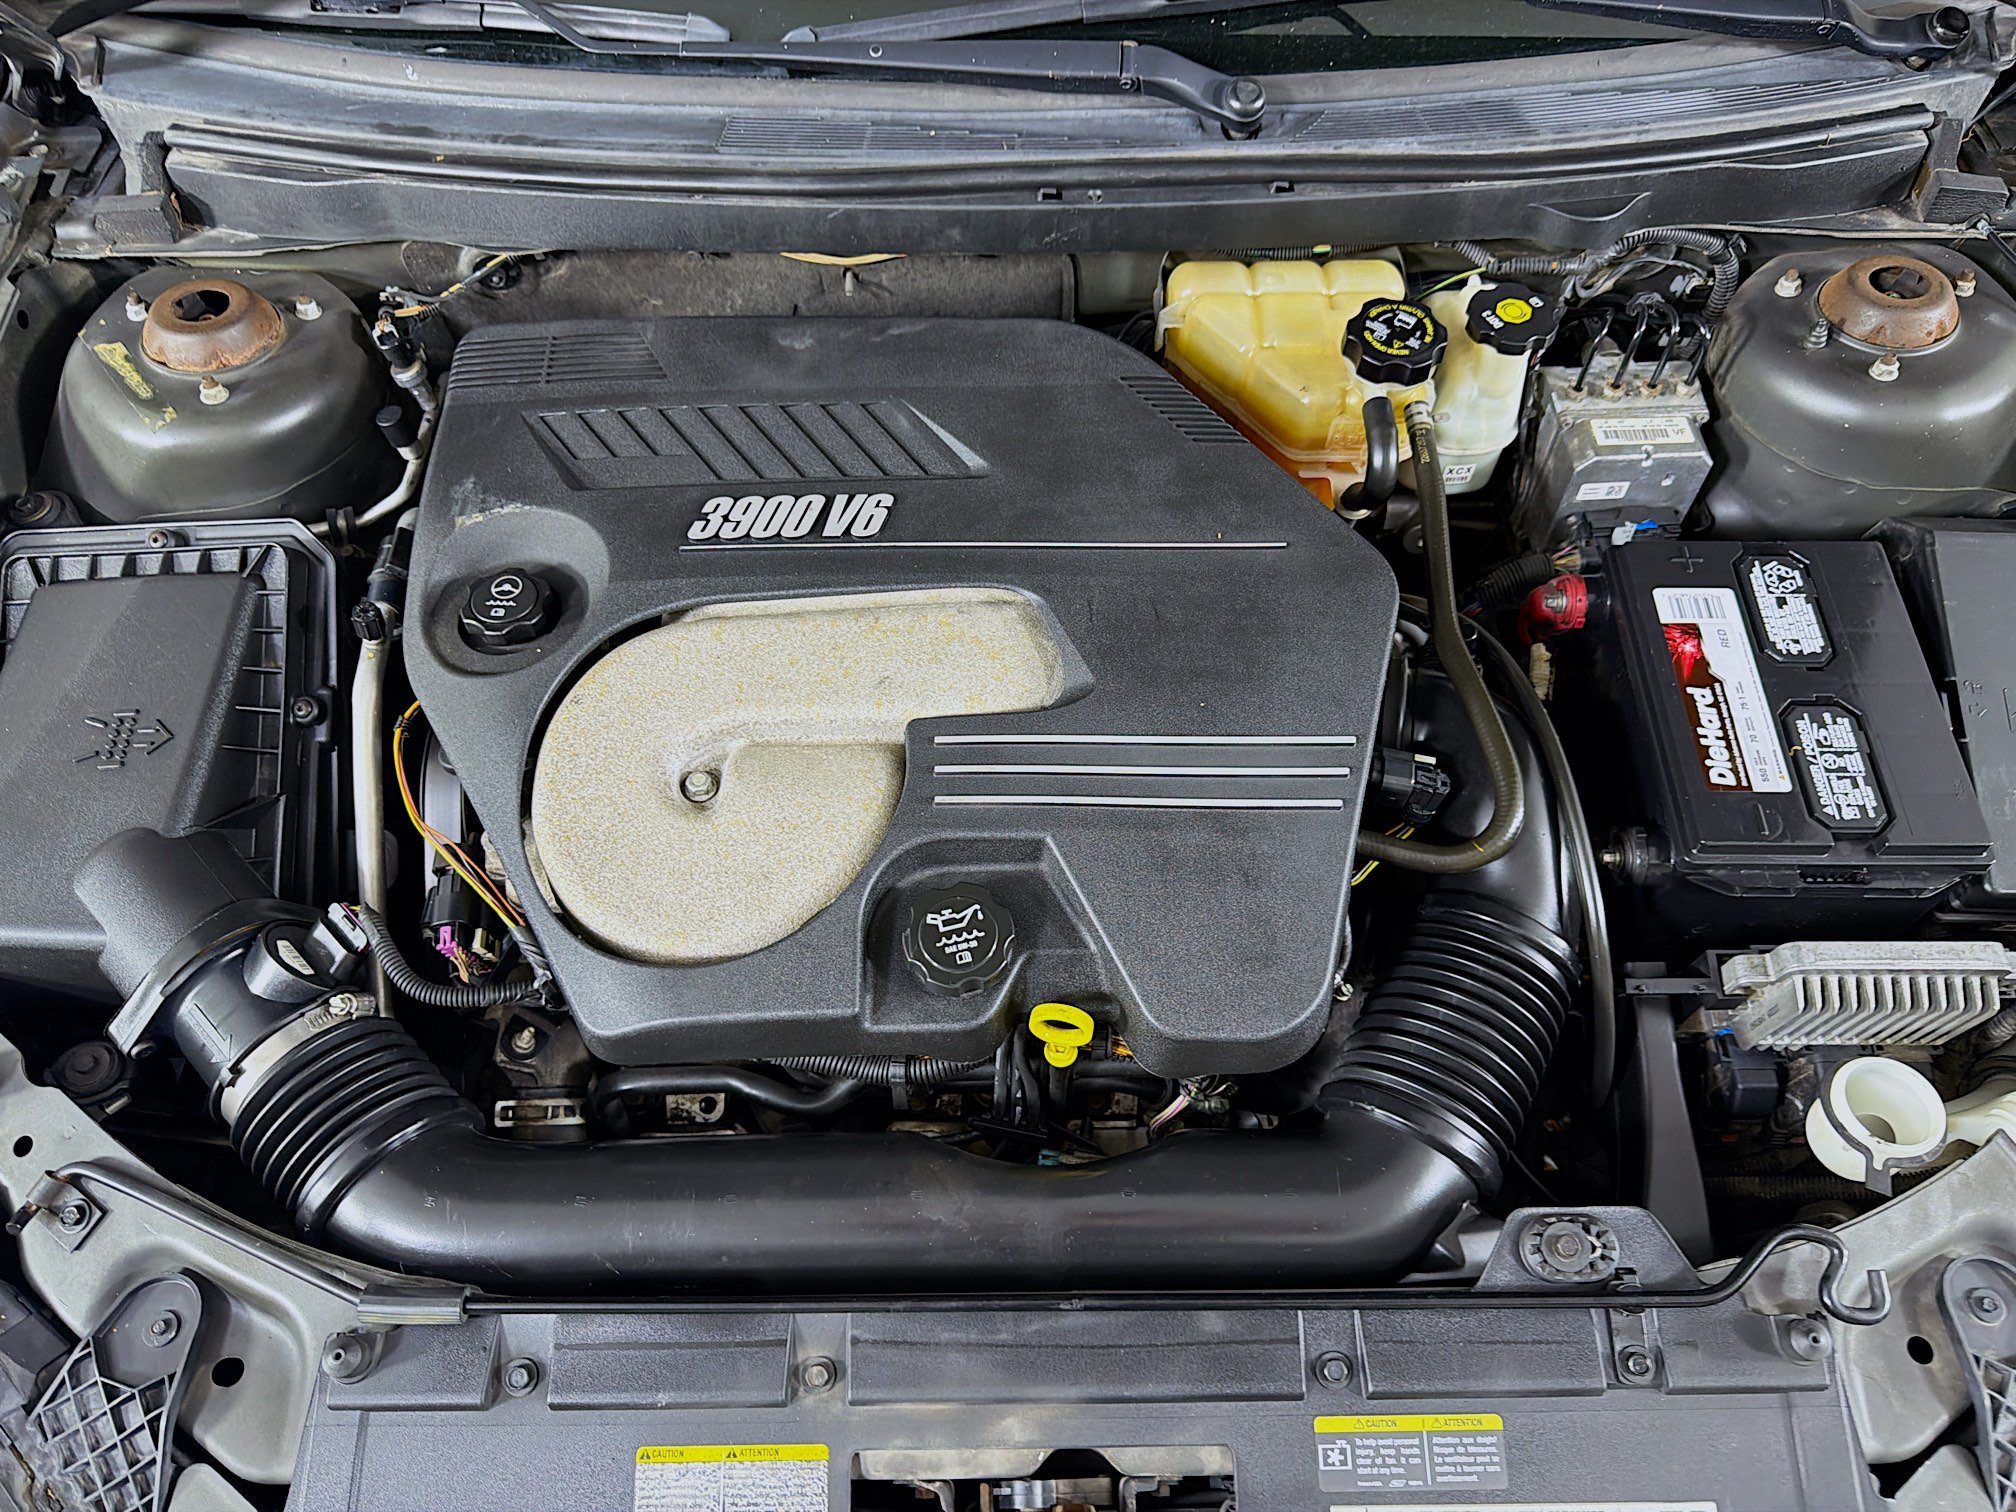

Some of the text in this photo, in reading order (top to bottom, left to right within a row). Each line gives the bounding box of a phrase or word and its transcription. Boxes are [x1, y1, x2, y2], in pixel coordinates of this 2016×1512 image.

[1485, 314, 1505, 329] DOT
[1371, 339, 1388, 352] OPEN
[1446, 466, 1473, 475] XCX
[687, 493, 895, 540] 3900 V6
[1716, 629, 1731, 648] RED
[1685, 686, 1738, 786] DieHard
[1795, 720, 1815, 756] POISON
[1759, 768, 1769, 782] 550
[1809, 764, 1831, 805] DANGER
[945, 945, 958, 954] SAE
[1366, 1419, 1397, 1428] CAUTION
[1443, 1418, 1483, 1427] ATTENTION
[652, 1450, 685, 1459] CAUTION
[739, 1448, 780, 1457] ATTENTION
